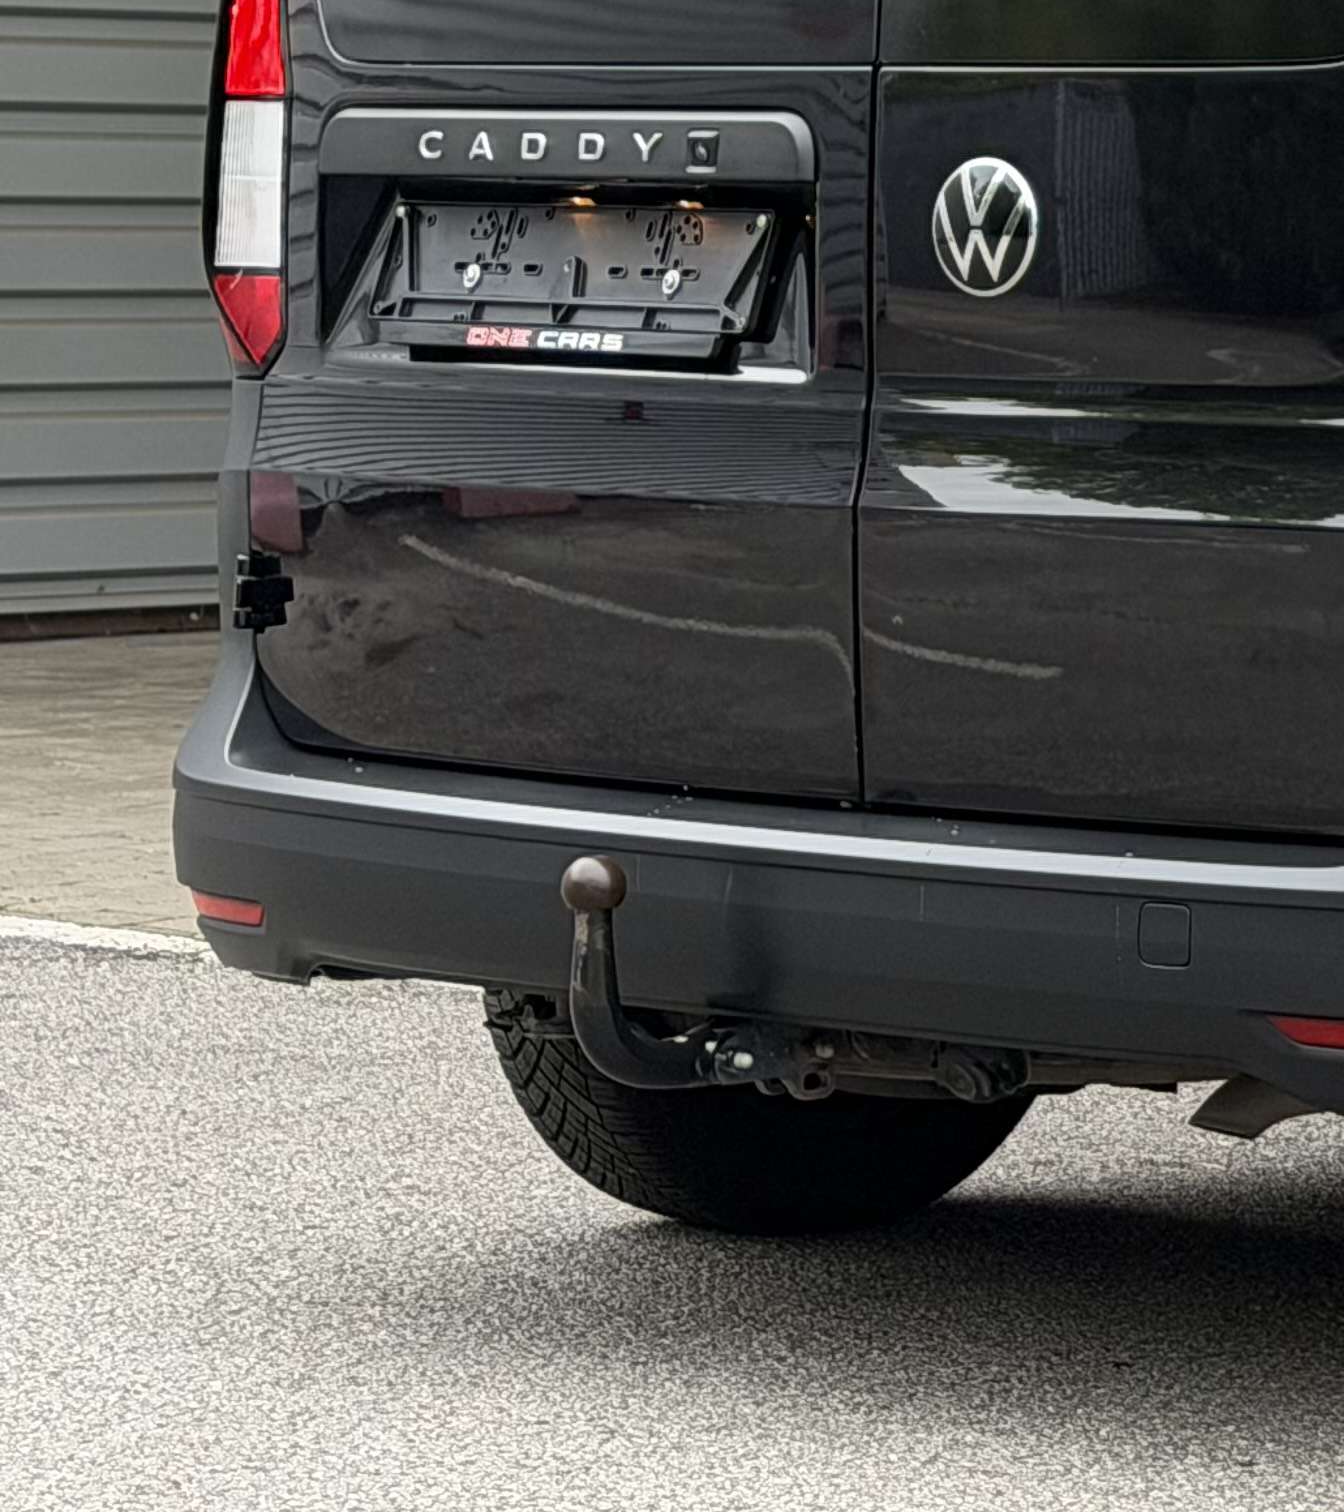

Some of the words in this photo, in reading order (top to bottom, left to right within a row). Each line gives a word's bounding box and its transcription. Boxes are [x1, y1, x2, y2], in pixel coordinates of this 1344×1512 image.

[417, 130, 663, 162] CADDY
[465, 326, 533, 348] ONE
[536, 331, 624, 352] CARS
